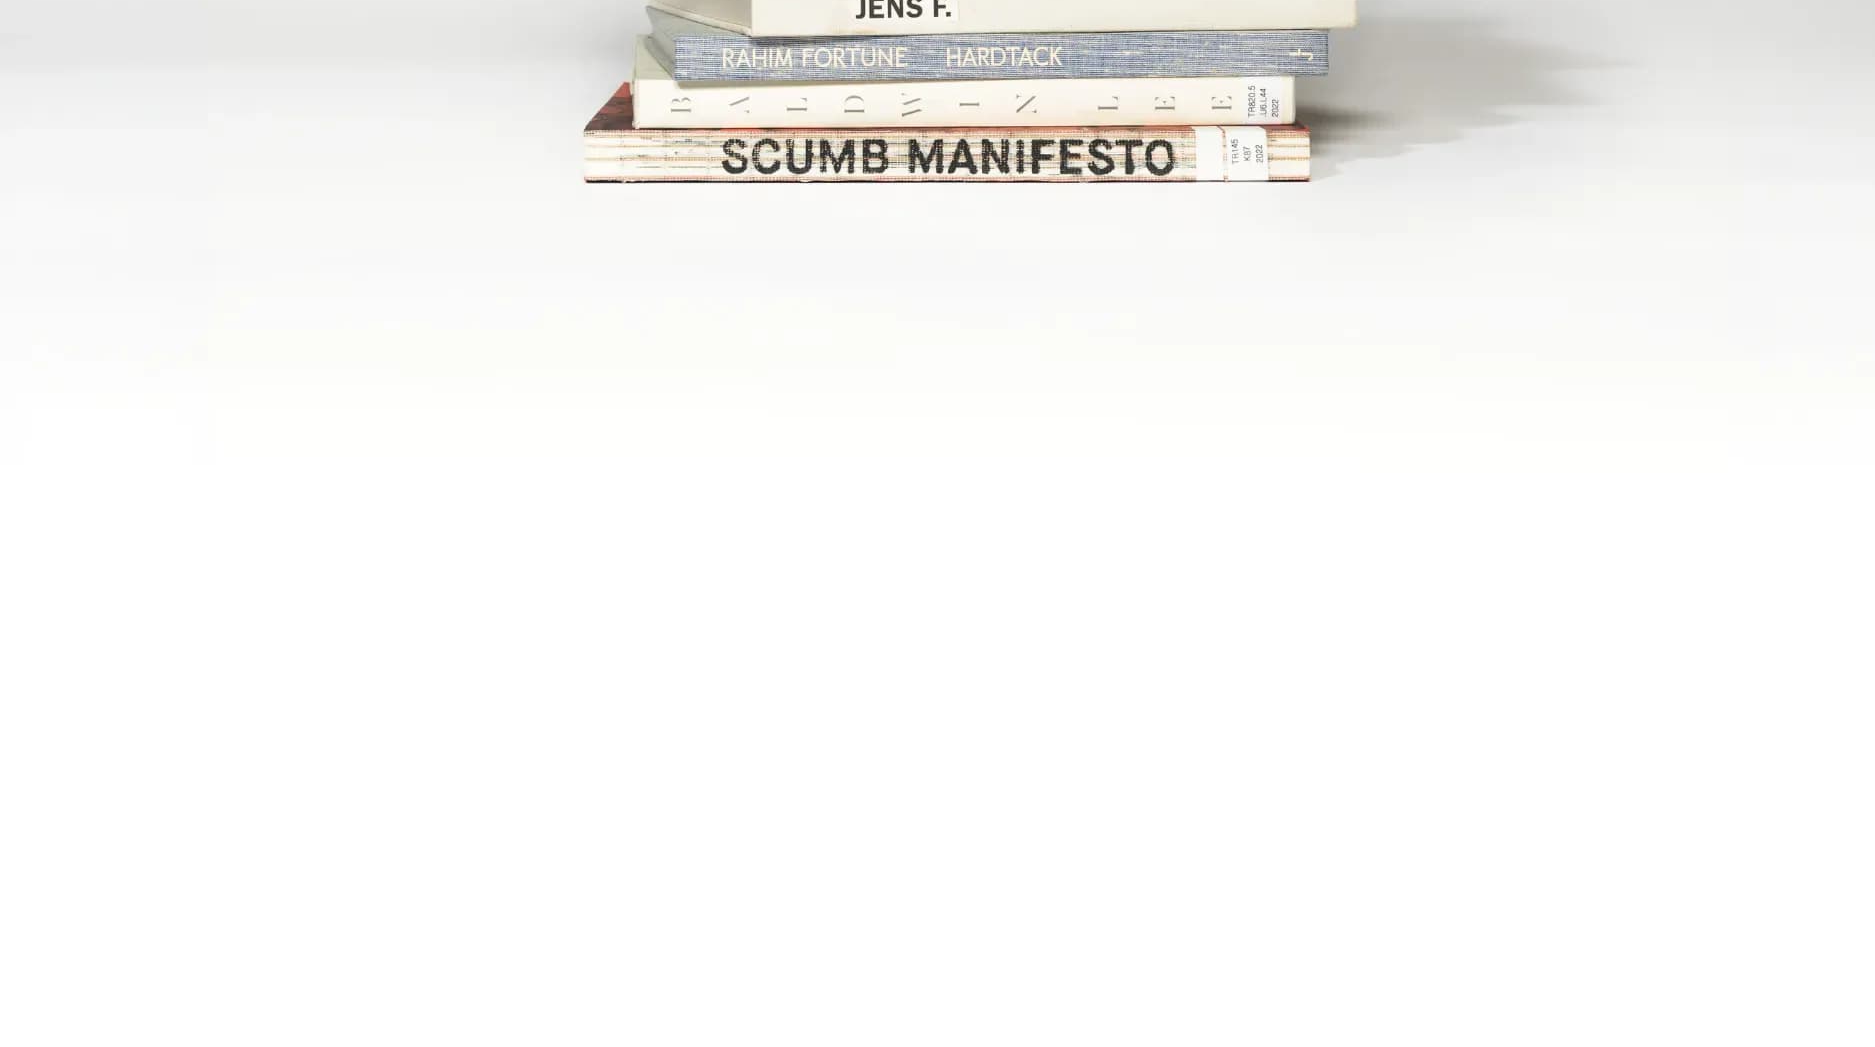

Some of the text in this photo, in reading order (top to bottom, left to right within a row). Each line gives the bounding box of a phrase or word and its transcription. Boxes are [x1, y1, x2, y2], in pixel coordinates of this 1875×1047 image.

[722, 46, 908, 68] RAHIM FORTUNE
[946, 46, 1062, 66] HARDTACK
[1248, 86, 1256, 118] TR820.5
[721, 138, 1175, 175] SCUMB MANIFESTO
[1231, 139, 1239, 165] TR145
[1255, 145, 1263, 163] 2022
